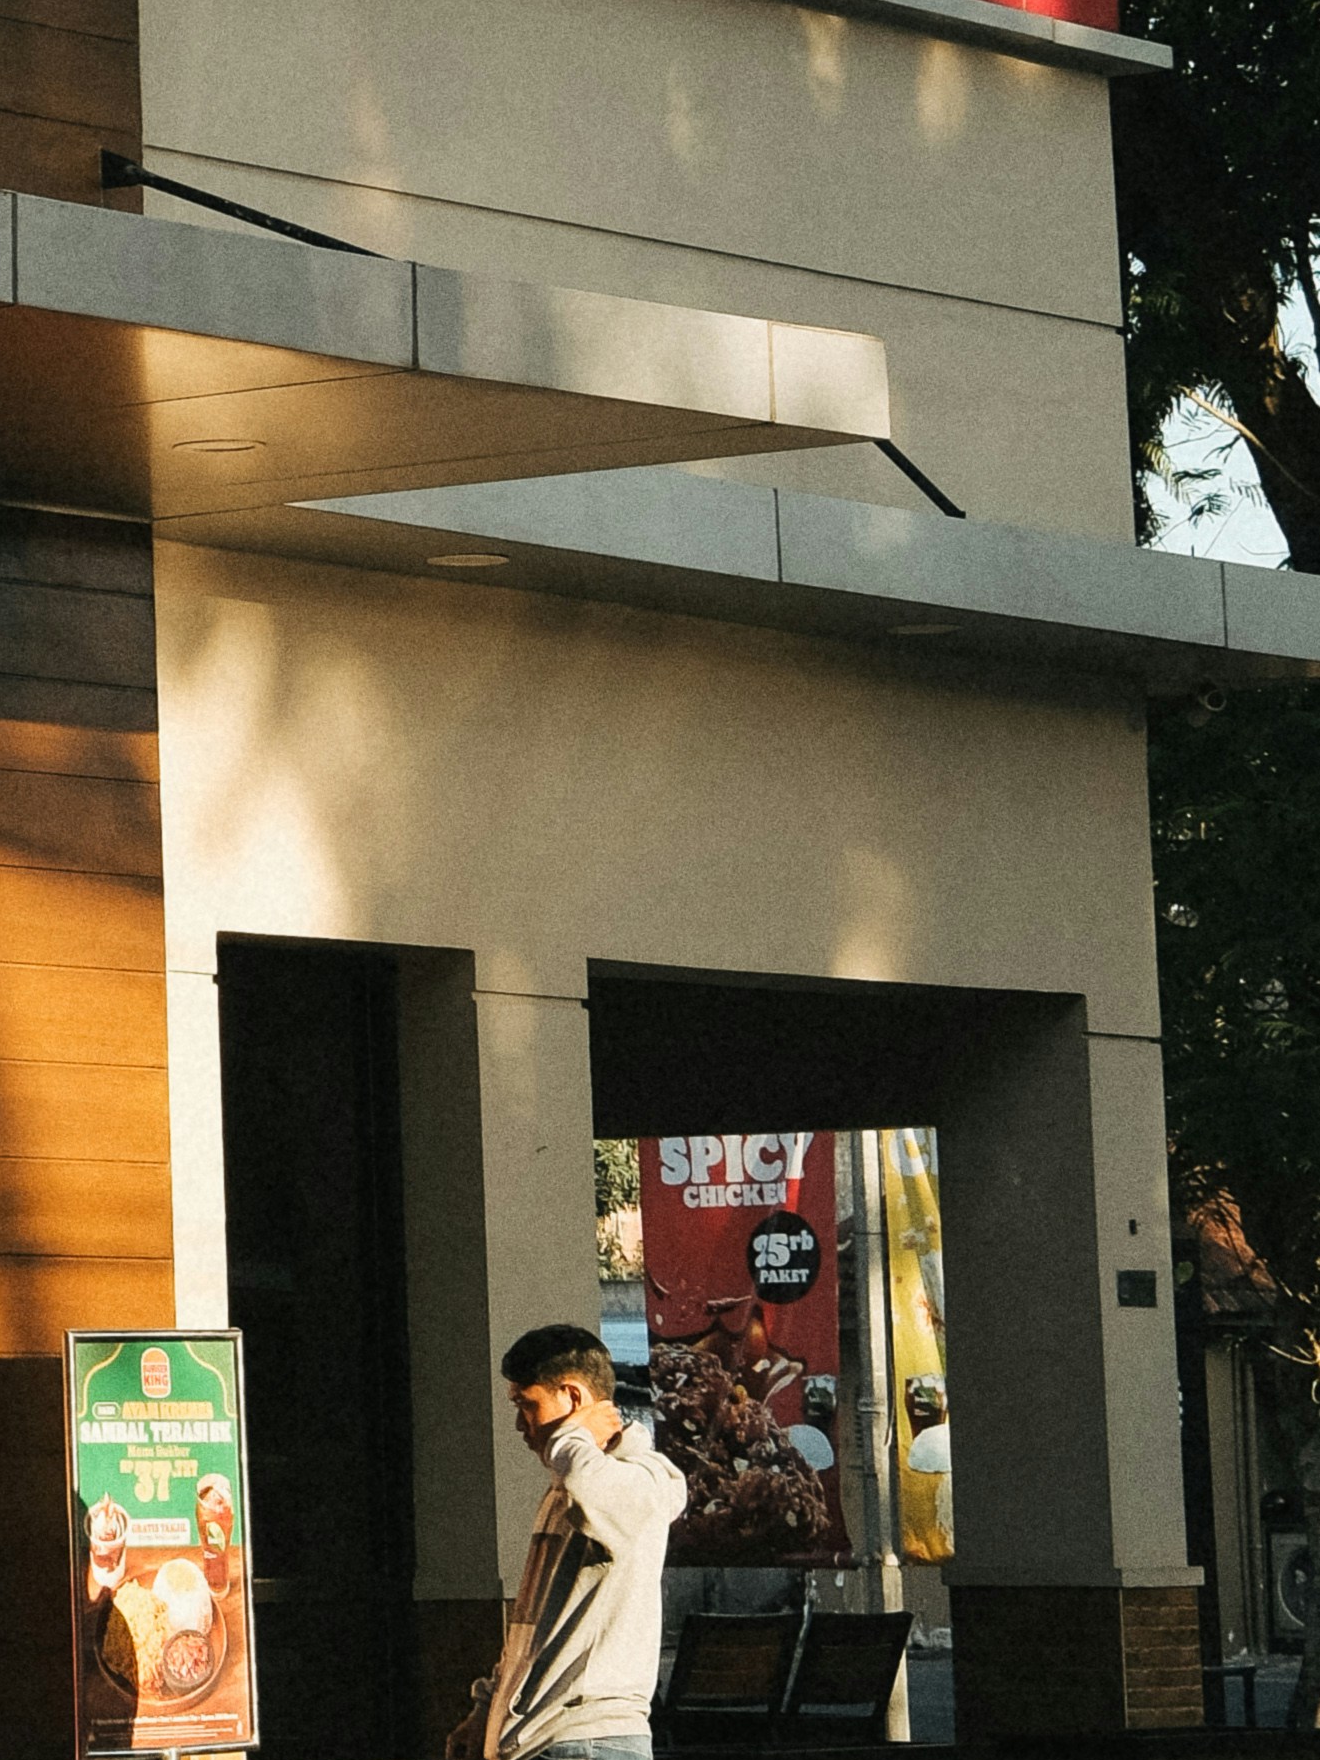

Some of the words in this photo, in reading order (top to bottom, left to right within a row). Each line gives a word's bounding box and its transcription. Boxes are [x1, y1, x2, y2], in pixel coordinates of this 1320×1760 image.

[659, 1132, 814, 1185] SPICY
[760, 1268, 810, 1284] PAKET
[143, 1374, 169, 1387] KING
[80, 1422, 148, 1443] SAMBAL
[150, 1422, 208, 1443] TERASI
